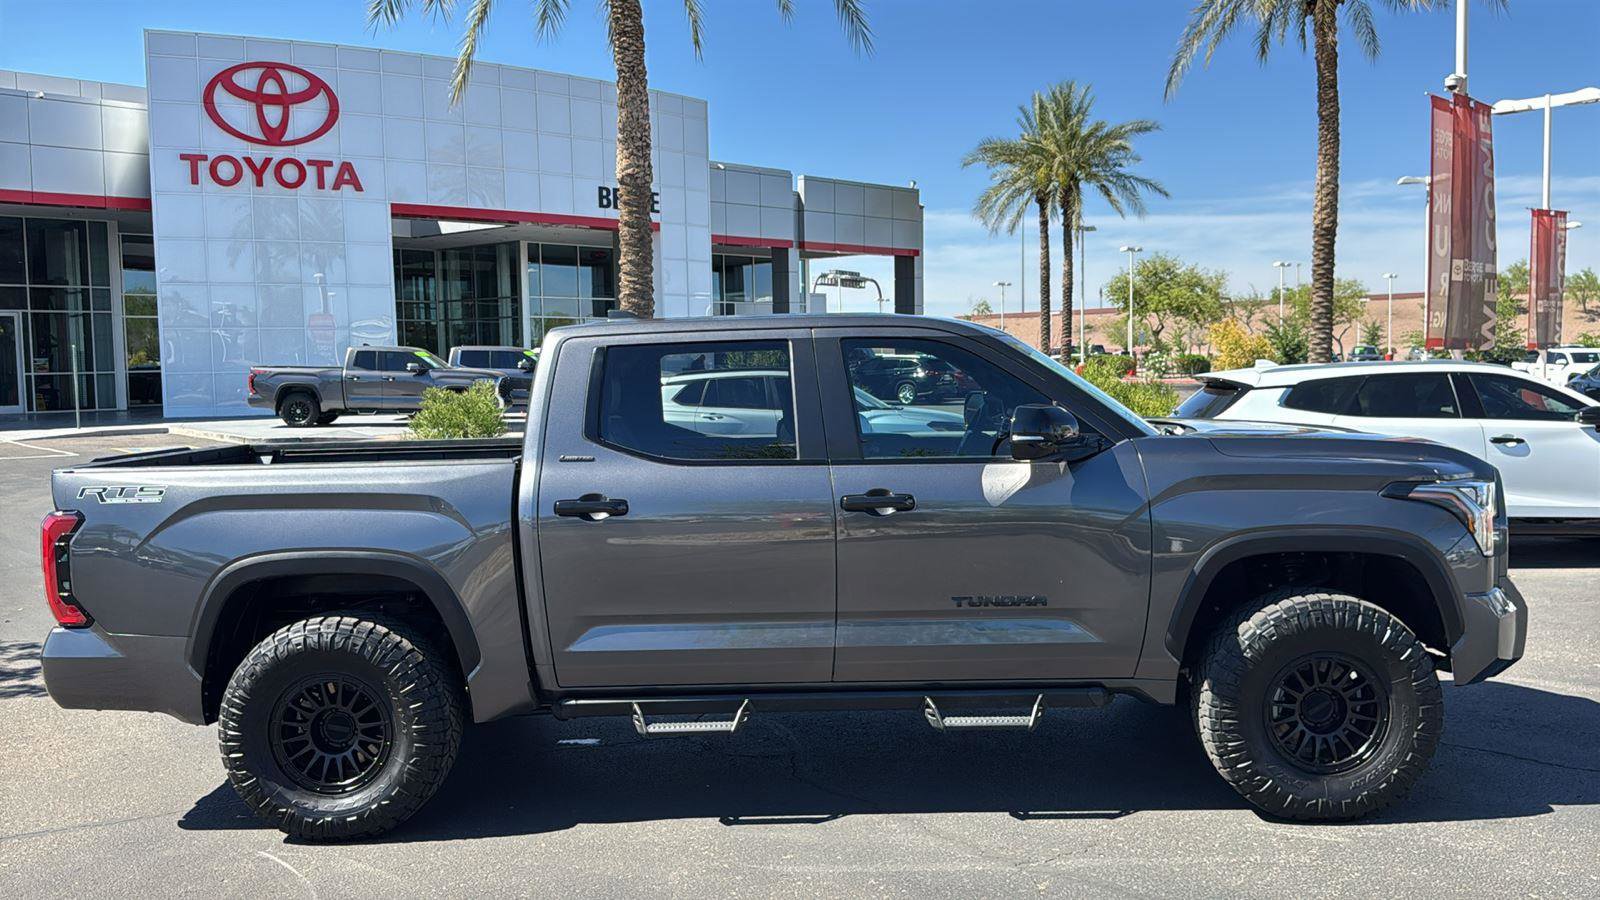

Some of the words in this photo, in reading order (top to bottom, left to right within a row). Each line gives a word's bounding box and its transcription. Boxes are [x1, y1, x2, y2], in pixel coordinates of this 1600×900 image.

[179, 154, 364, 192] TOYOTA
[598, 186, 660, 213] BEE
[1479, 110, 1498, 350] WELCOME
[951, 595, 1048, 607] TUNDRA
